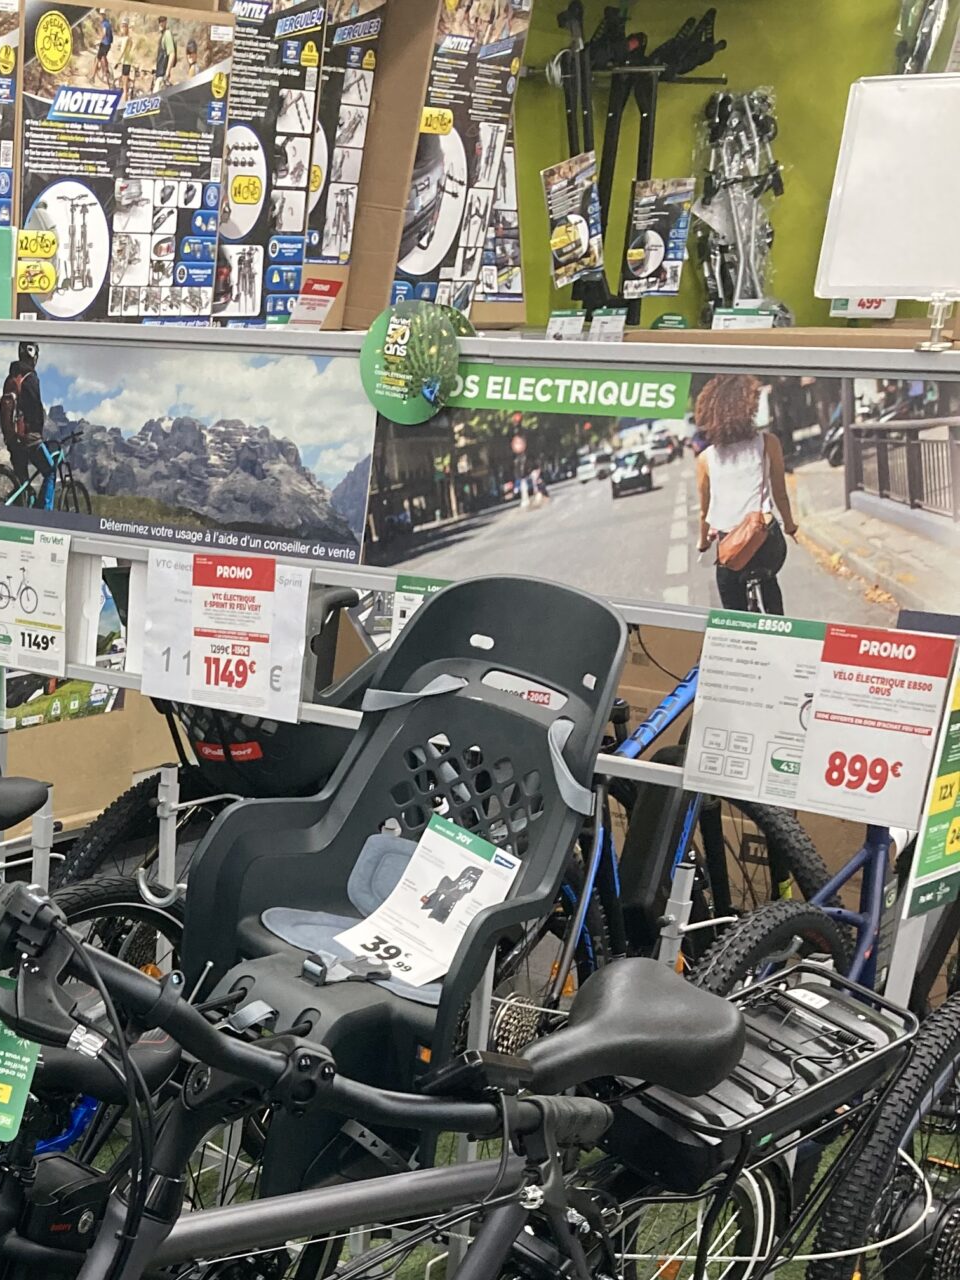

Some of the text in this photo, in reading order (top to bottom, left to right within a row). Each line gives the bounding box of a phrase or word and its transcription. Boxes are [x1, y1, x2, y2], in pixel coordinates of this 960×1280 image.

[42, 18, 66, 33] SPECIAL
[56, 90, 115, 114] MOTTEZ
[19, 237, 30, 250] x2
[386, 323, 410, 344] 50
[384, 344, 407, 356] ans
[486, 376, 677, 409] ELECTRIQUES
[40, 535, 64, 545] Feu Vert
[100, 518, 356, 560] Déterminez votre usage à l'aide d'un conseiller de vente
[156, 559, 172, 569] VTC
[217, 566, 252, 579] PROMO
[276, 576, 302, 588] -Sprint
[758, 619, 792, 633] E8500
[21, 632, 56, 650] 1149€
[210, 644, 230, 655] 1299€
[858, 639, 916, 660] PROMO
[204, 657, 256, 688] 1149€
[270, 664, 283, 692] €
[833, 670, 932, 692] VÉLO ÉLECTRIQUE E8500
[528, 692, 550, 704] -200€
[869, 686, 891, 696] ORUS
[825, 751, 903, 793] 899€
[456, 832, 473, 846] JOY
[360, 935, 402, 960] 39
[393, 961, 412, 973] 99
